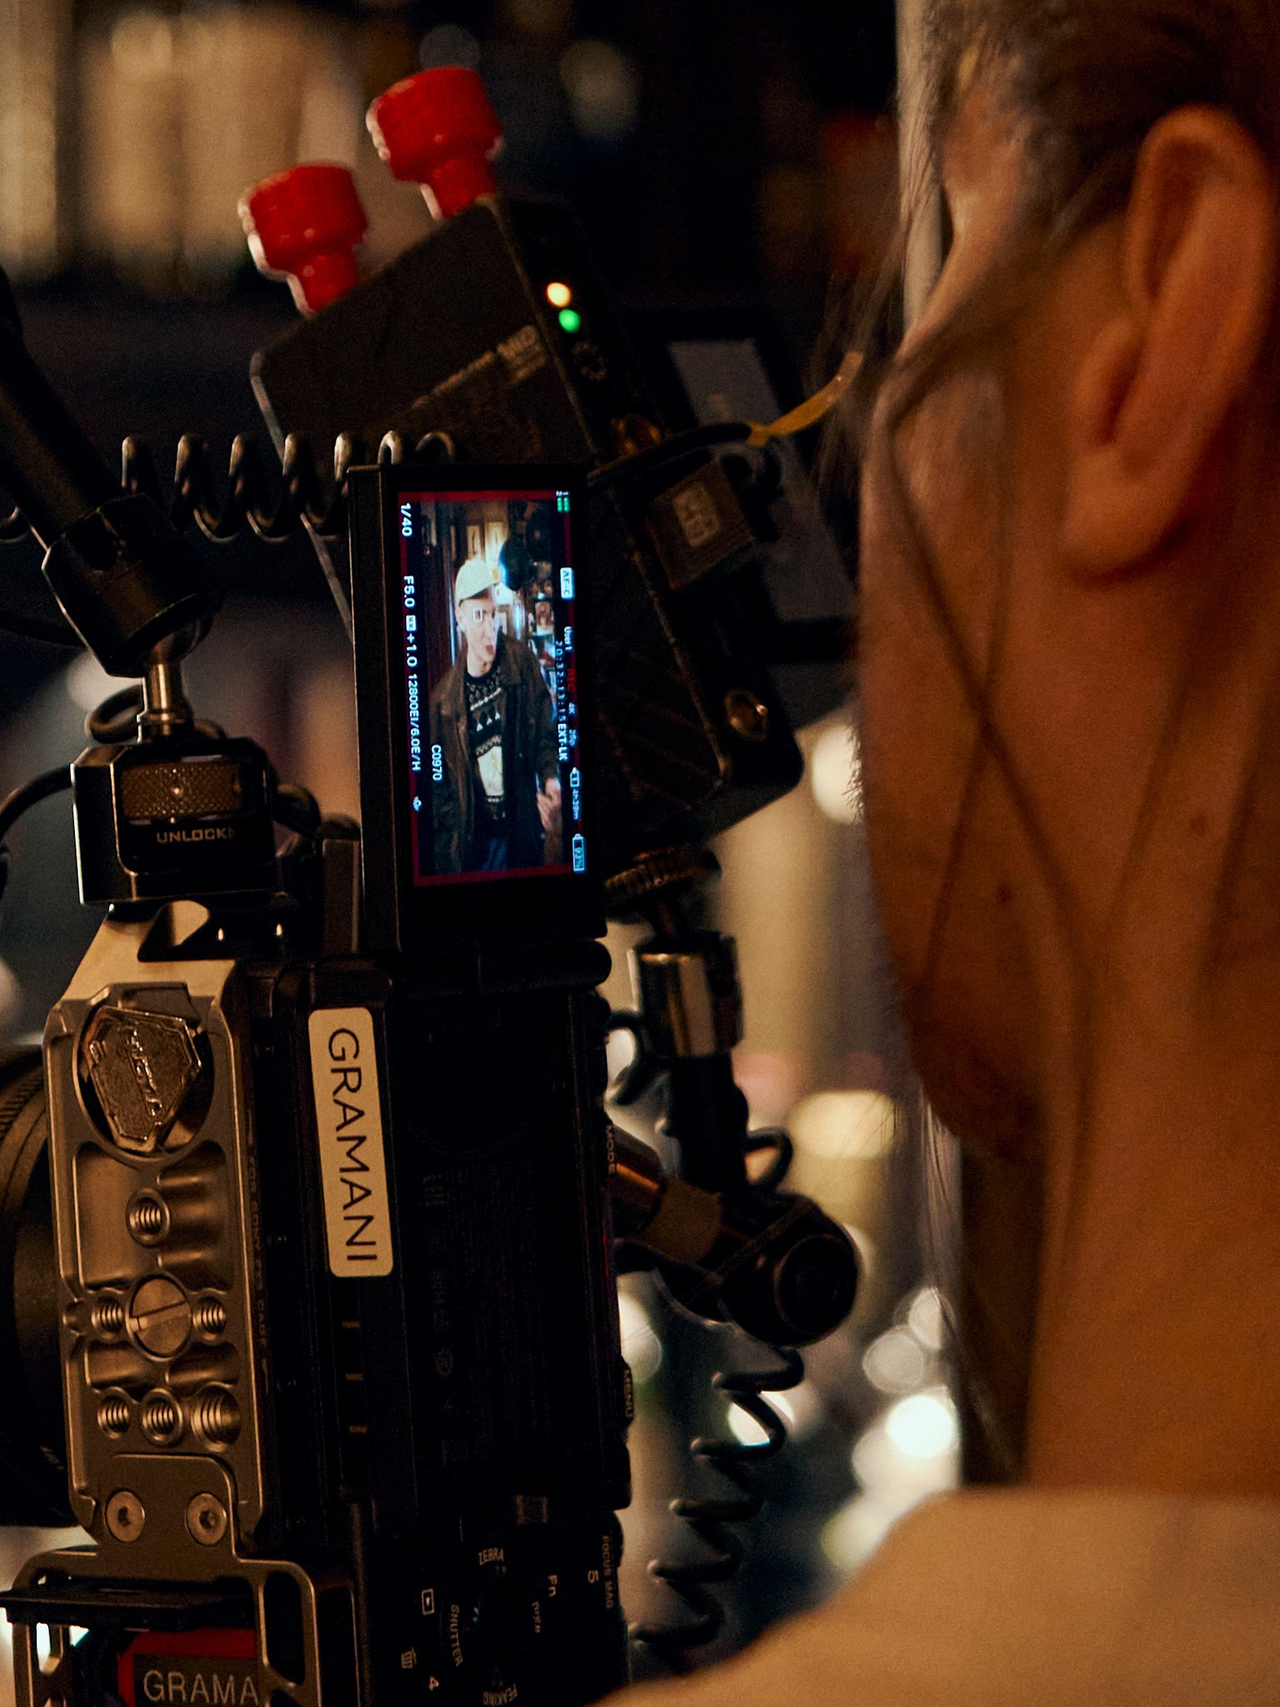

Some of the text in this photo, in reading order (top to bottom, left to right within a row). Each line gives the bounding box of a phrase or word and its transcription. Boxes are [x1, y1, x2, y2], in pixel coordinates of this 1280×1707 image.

[400, 502, 413, 537] 1/40
[403, 575, 416, 608] F5.0
[406, 633, 418, 667] +1.0
[567, 668, 577, 693] REC
[408, 673, 421, 771] 12800EI/6.0E/H
[558, 723, 569, 761] EXT-LK
[431, 744, 442, 781] C0970
[156, 827, 228, 844] UNLOCK
[328, 1028, 377, 1261] GRAMANI
[606, 1123, 617, 1175] MODE
[622, 1369, 634, 1423] MENU
[477, 1546, 505, 1566] ZEBRA
[547, 1574, 558, 1598] Fn
[587, 1569, 600, 1584] 5
[449, 1603, 464, 1668] SHUTTER
[428, 1674, 440, 1692] 4
[481, 1683, 519, 1707] PEAKING
